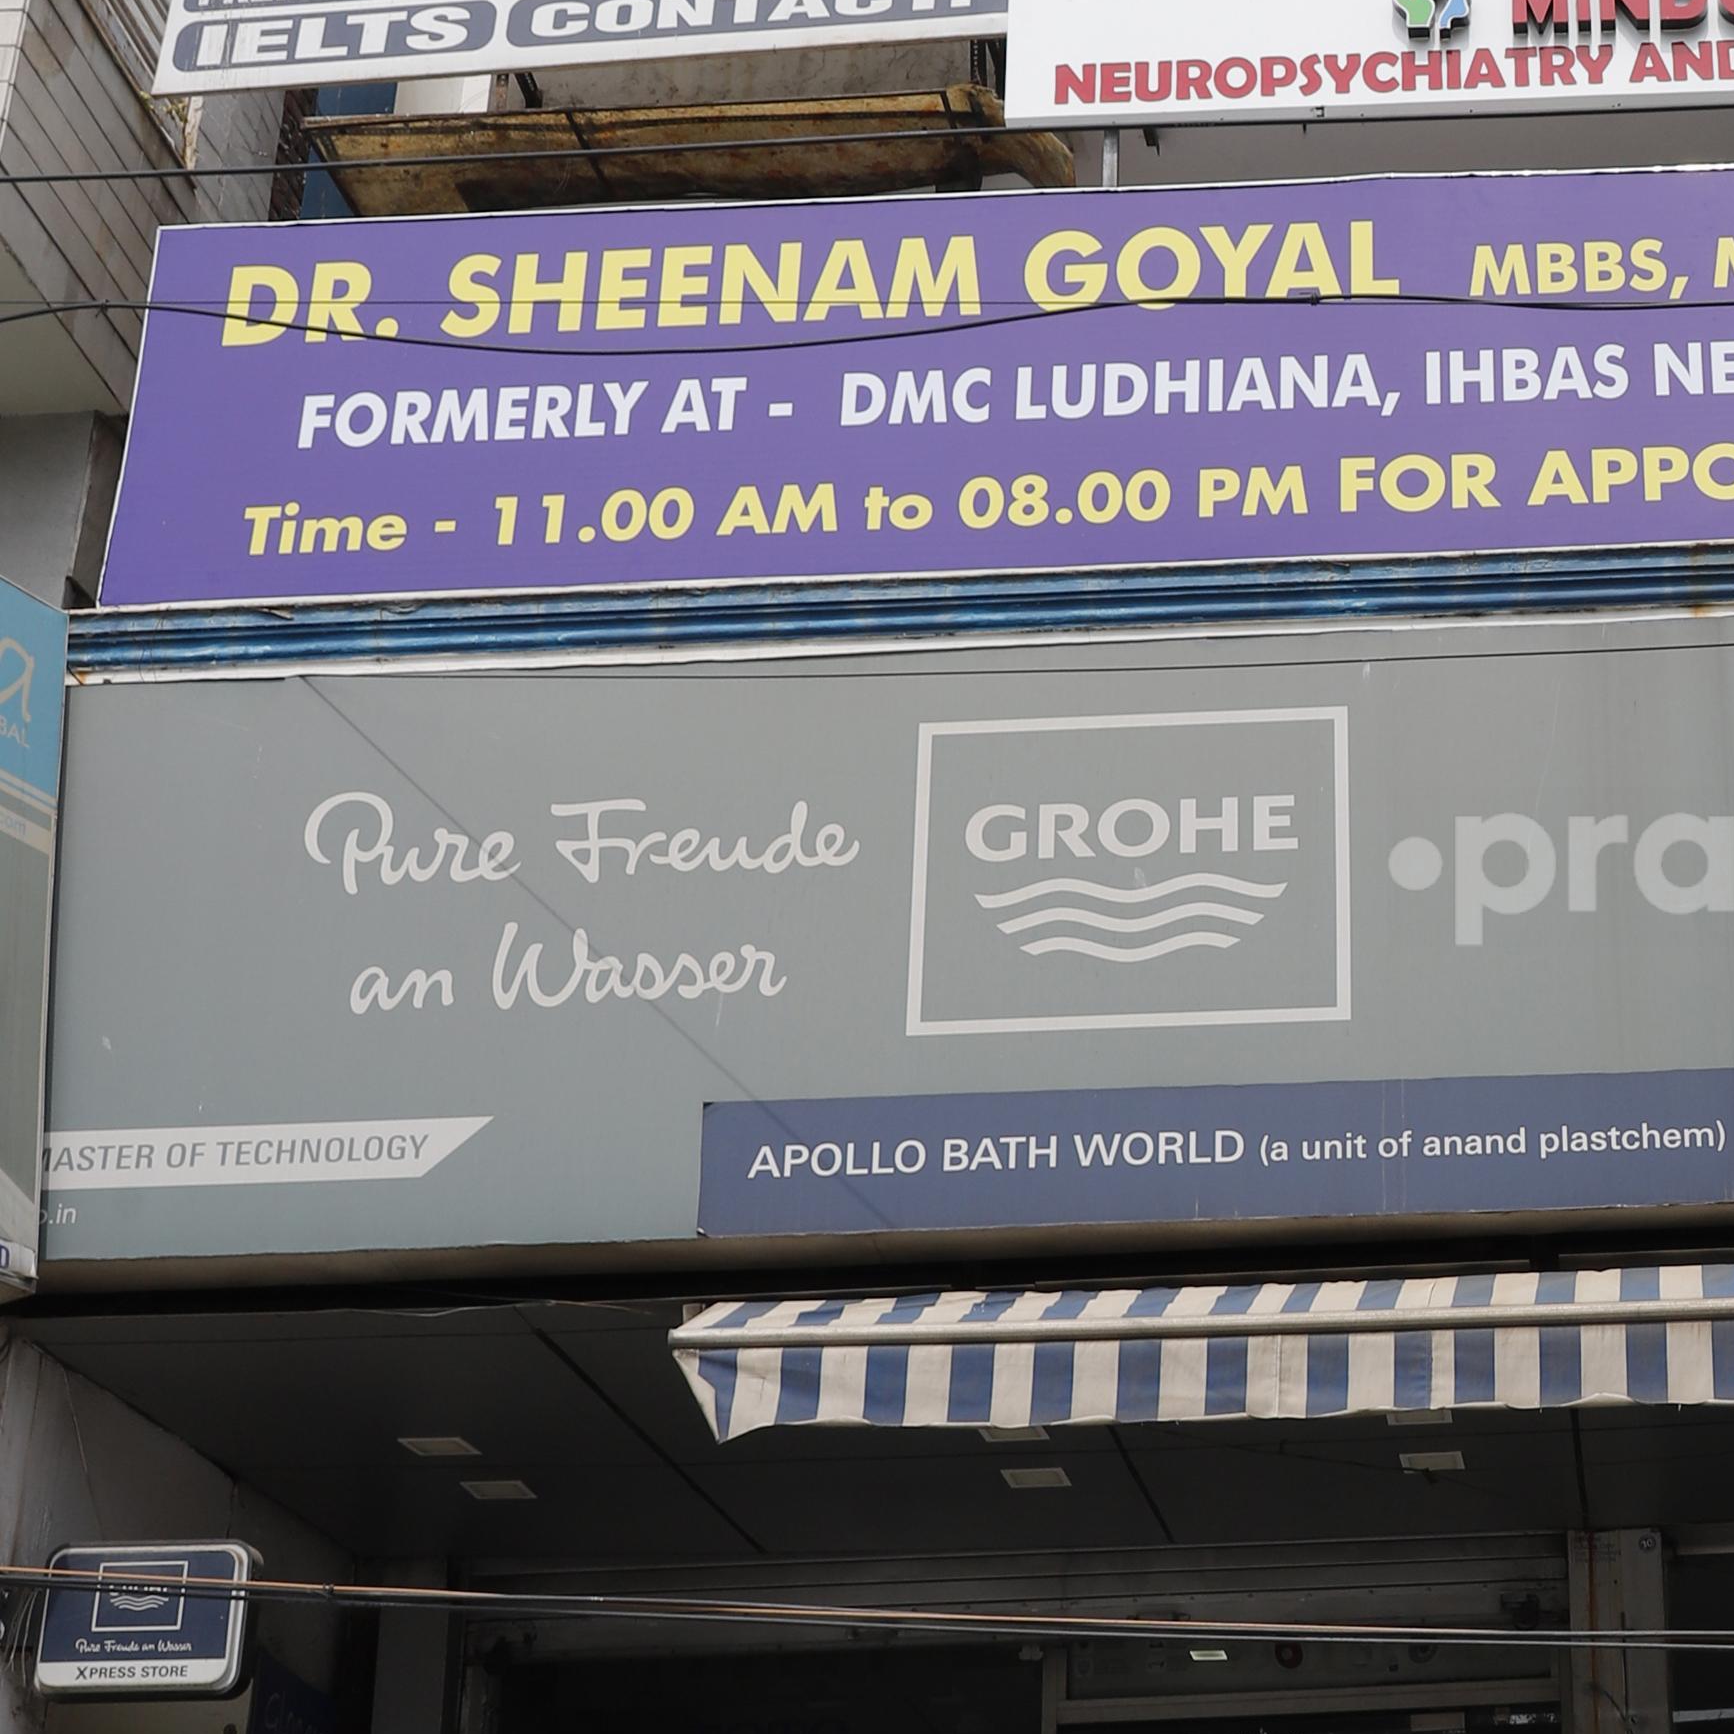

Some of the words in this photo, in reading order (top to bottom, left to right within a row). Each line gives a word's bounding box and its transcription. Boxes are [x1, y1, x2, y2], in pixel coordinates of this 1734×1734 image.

[195, 5, 473, 68] IELTS
[1054, 45, 1612, 105] NEUROPSYCHIATRY
[222, 261, 400, 347] DR.
[440, 235, 982, 338] SHEENAM
[1024, 220, 1400, 312] GOYAL
[1470, 239, 1689, 299] MBBS,
[298, 379, 649, 449] FORMERLY
[661, 376, 748, 433] AT
[840, 368, 992, 427] DMC
[1015, 352, 1401, 418] LUDHIANA,
[1425, 343, 1629, 405] IHBAS
[243, 501, 407, 556] Time
[495, 487, 694, 546] 11.00
[717, 482, 838, 536] AM
[865, 484, 934, 530] to
[958, 469, 1170, 529] 08.00
[1198, 465, 1308, 518] PM
[1340, 453, 1500, 513] FOR
[304, 791, 522, 895] Pure
[551, 798, 859, 883] Freude
[965, 793, 1299, 861] GROHE
[350, 963, 454, 1015] an
[492, 921, 786, 1011] Wasser
[167, 1134, 206, 1169] OF
[215, 1130, 430, 1167] TECHNOLOGY
[747, 1139, 927, 1179] APOLLO
[941, 1135, 1057, 1173] BATH
[1074, 1130, 1244, 1167] WORLD
[1301, 1129, 1366, 1161] unit
[1377, 1127, 1412, 1159] of
[1422, 1125, 1526, 1156] anand
[1539, 1120, 1727, 1160] plastchem)
[75, 1666, 136, 1681] XPRESS
[141, 1665, 189, 1678] STORE
